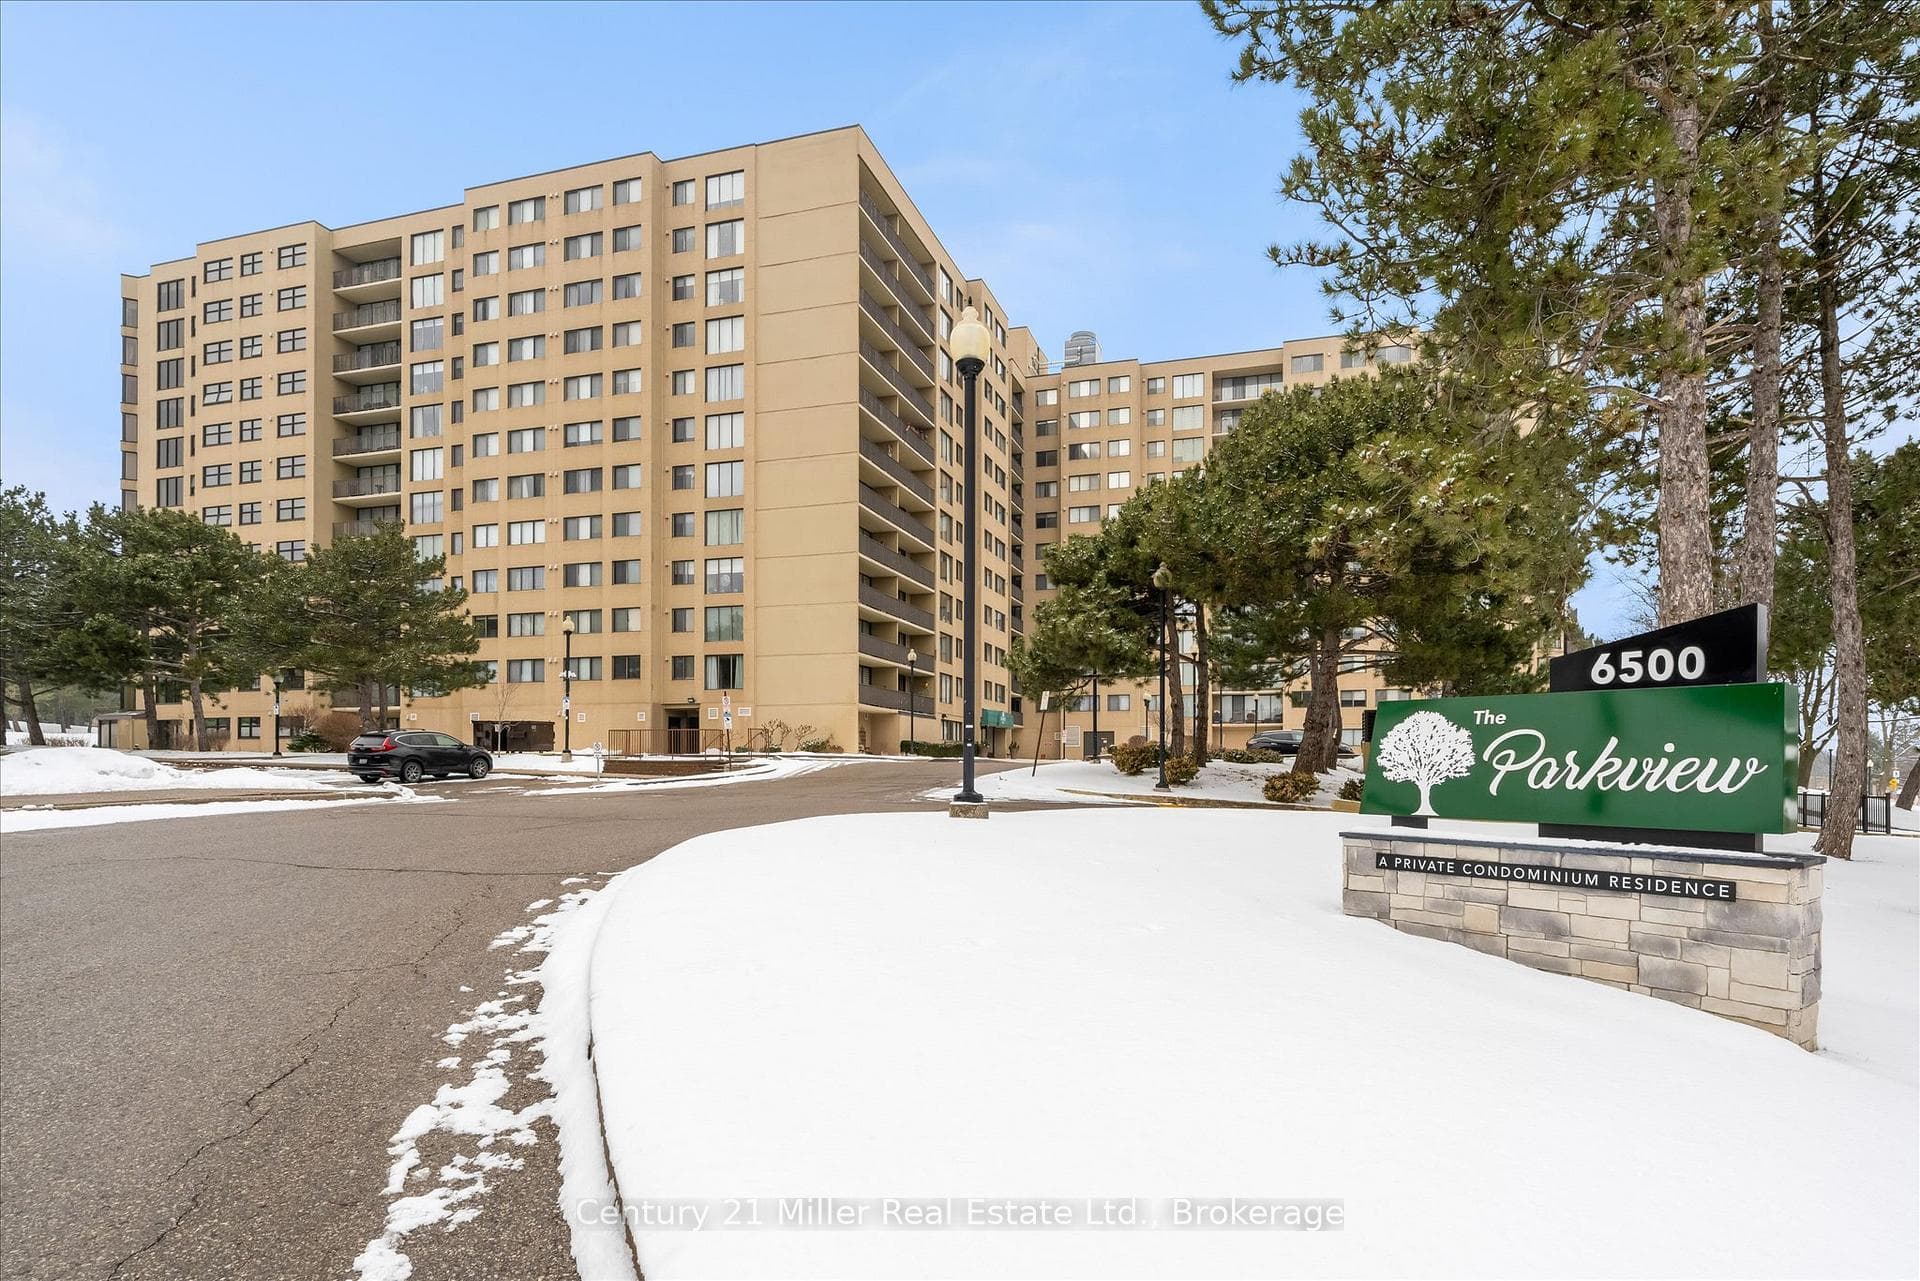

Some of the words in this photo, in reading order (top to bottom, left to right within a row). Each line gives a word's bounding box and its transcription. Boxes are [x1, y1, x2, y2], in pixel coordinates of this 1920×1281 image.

[1590, 645, 1706, 686] 6500
[1473, 709, 1507, 726] The
[1482, 728, 1769, 797] Parkview
[1378, 855, 1389, 868] A
[1394, 857, 1456, 874] PRIVATE
[1461, 862, 1599, 887] CONDOMINIUM
[1608, 874, 1731, 899] RESIDENCE
